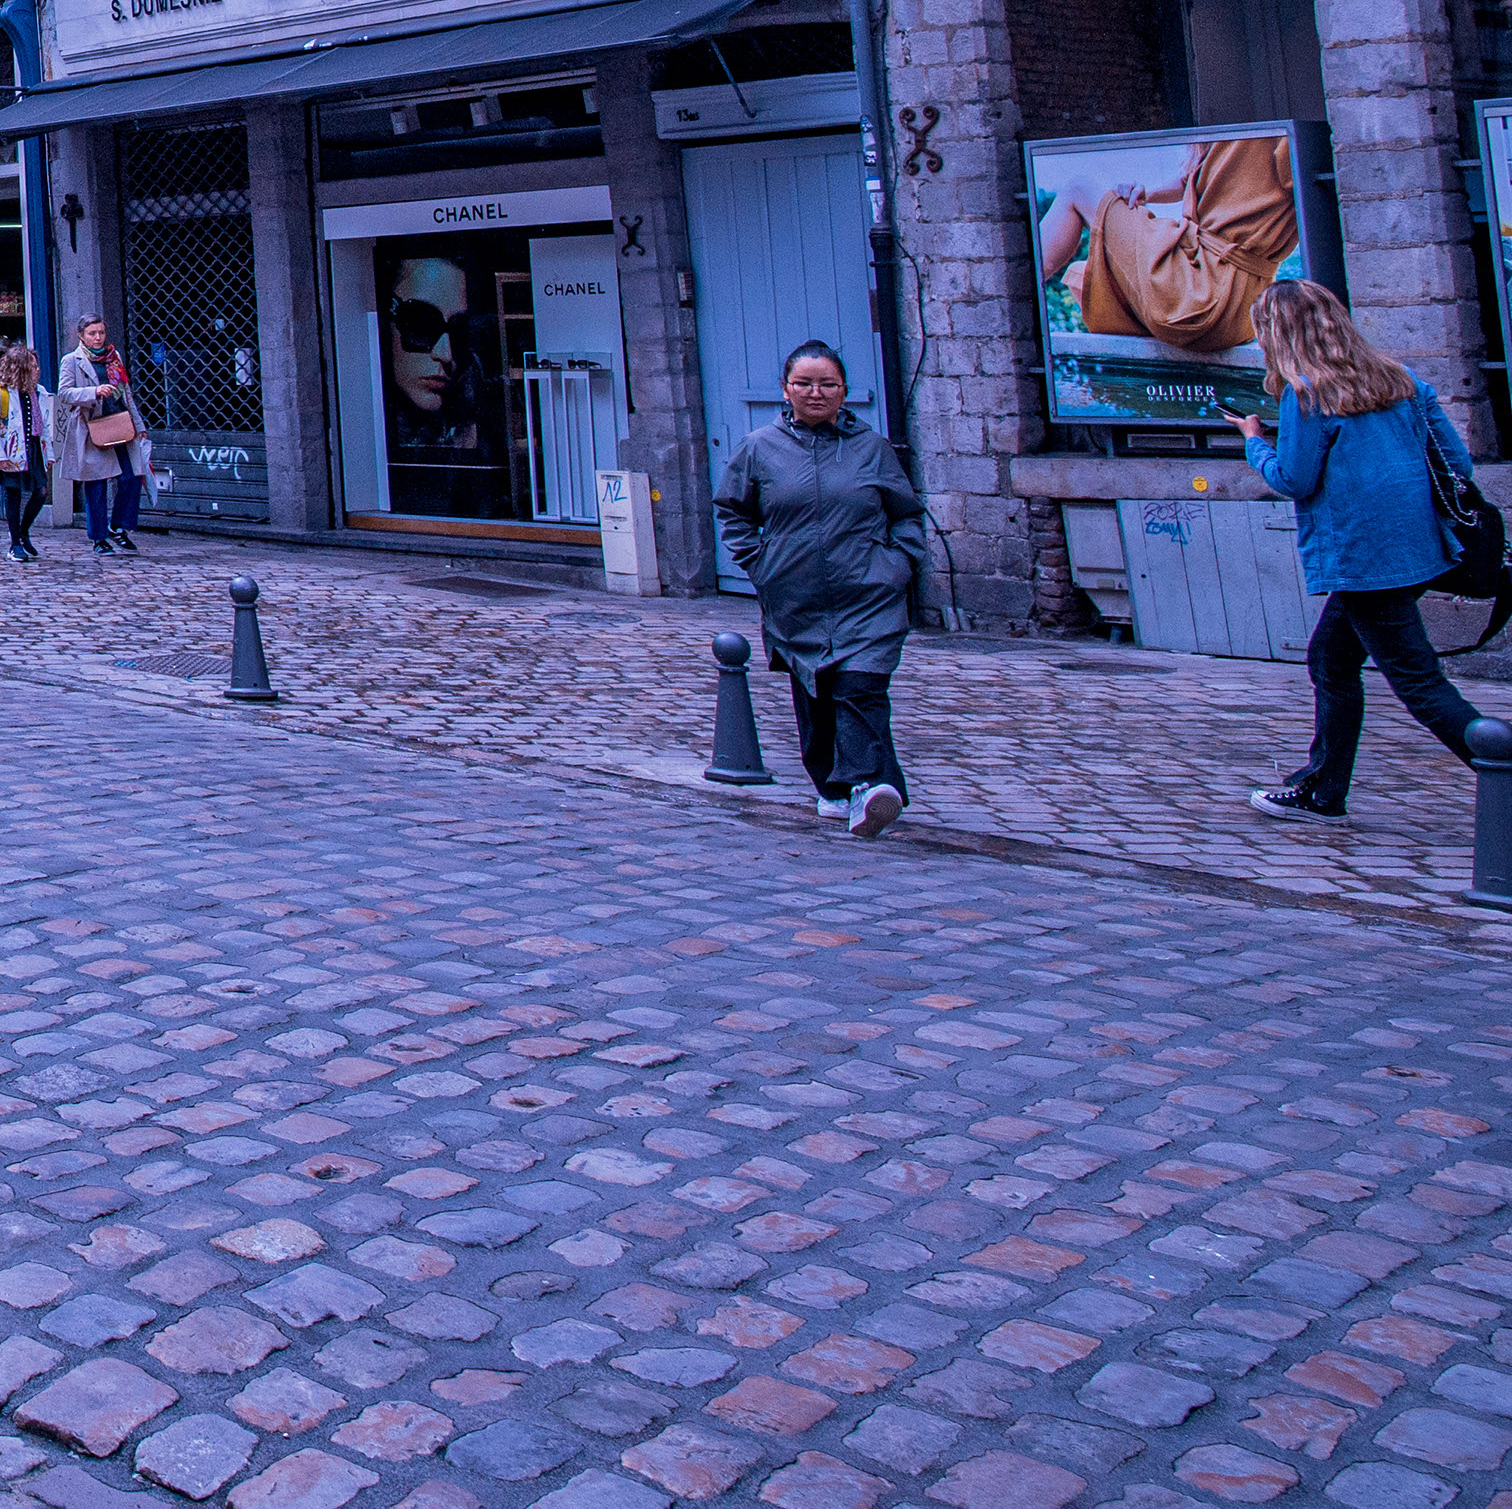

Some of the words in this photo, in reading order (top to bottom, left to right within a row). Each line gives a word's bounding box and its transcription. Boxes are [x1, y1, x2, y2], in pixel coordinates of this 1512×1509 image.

[110, 0, 128, 23] S.
[433, 203, 508, 224] CHANEL
[544, 282, 606, 297] CHANEL
[1146, 385, 1215, 397] OLIVIER
